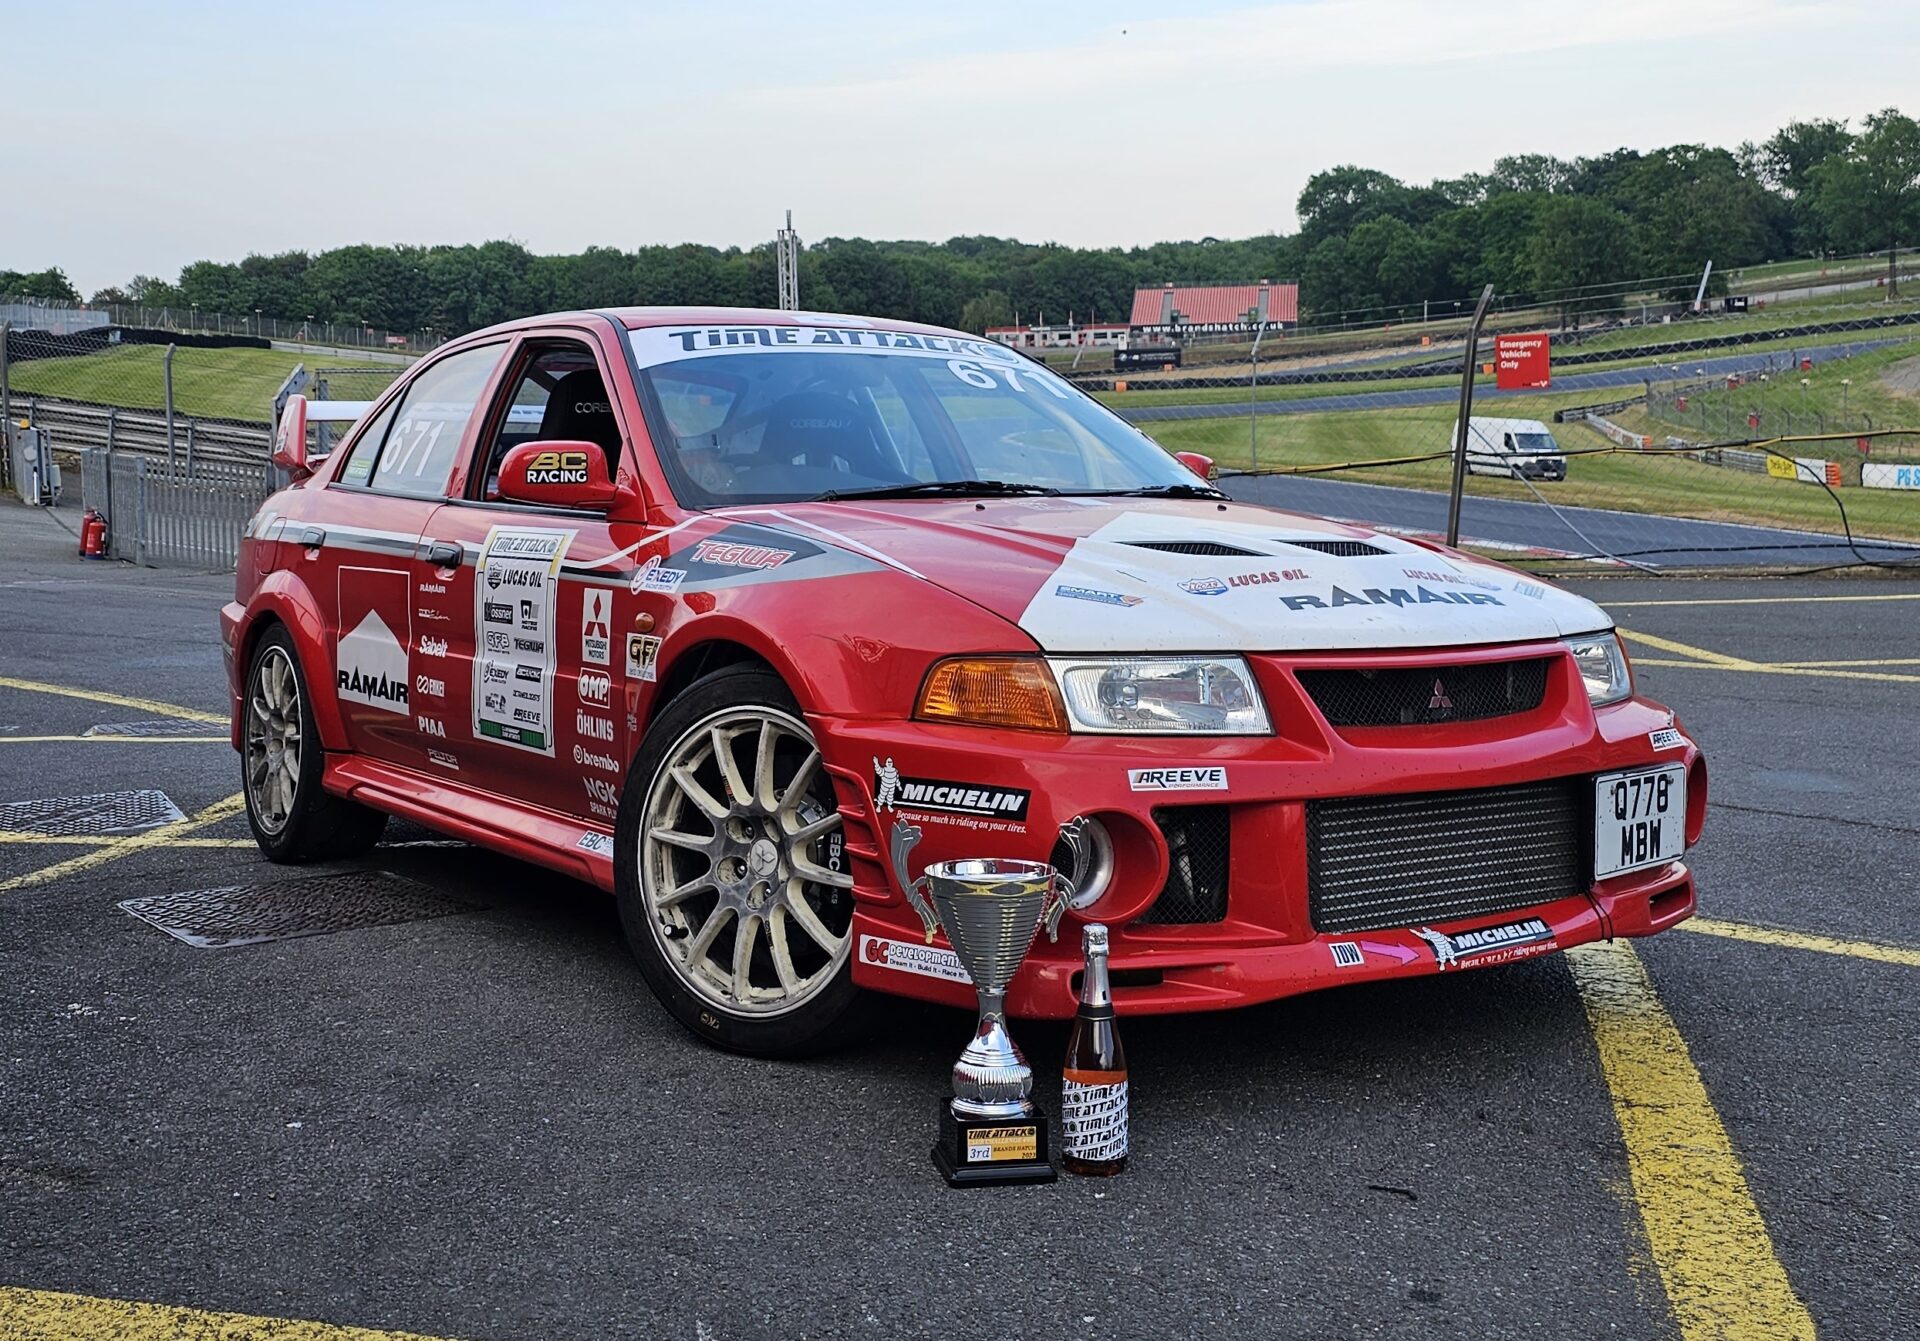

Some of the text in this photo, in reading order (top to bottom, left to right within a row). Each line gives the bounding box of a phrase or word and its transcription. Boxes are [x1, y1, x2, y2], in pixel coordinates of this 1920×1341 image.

[1500, 340, 1542, 349] Emergency
[1500, 350, 1531, 359] Vehicles
[1500, 360, 1519, 370] Only
[947, 359, 1068, 399] 671
[381, 418, 444, 477] 671
[527, 471, 588, 483] RACING
[503, 569, 542, 588] LUCAS OIL
[646, 569, 684, 583] EXEDY
[1229, 569, 1309, 588] LUCAS OIL
[1402, 569, 1443, 582] LUCAS
[1280, 585, 1506, 611] RAMAIR
[420, 635, 448, 657] Sabelt
[338, 666, 409, 704] RAMAIR
[418, 716, 446, 738] PIAA
[577, 709, 614, 742] ÖHLINS
[583, 748, 619, 773] brembo
[583, 776, 619, 807] NGK
[902, 784, 1024, 811] MICHELIN
[1614, 773, 1669, 820] Q778
[896, 809, 921, 821] Because
[922, 814, 929, 822] so
[930, 814, 949, 824] much
[949, 817, 956, 825] is
[957, 817, 978, 830] riding
[989, 822, 1007, 832] your
[1007, 822, 1027, 834] tires.
[578, 831, 607, 850] EBC
[1621, 818, 1662, 867] MBW
[828, 833, 842, 871] EBC
[1455, 920, 1547, 949] MICHELIN
[866, 939, 889, 965] GC
[1334, 945, 1363, 965] TOW
[890, 958, 907, 966] Dream
[918, 963, 931, 972] Build
[942, 969, 957, 977] Race
[992, 1128, 1026, 1137] ATTACK
[970, 1147, 990, 1158] 3rd
